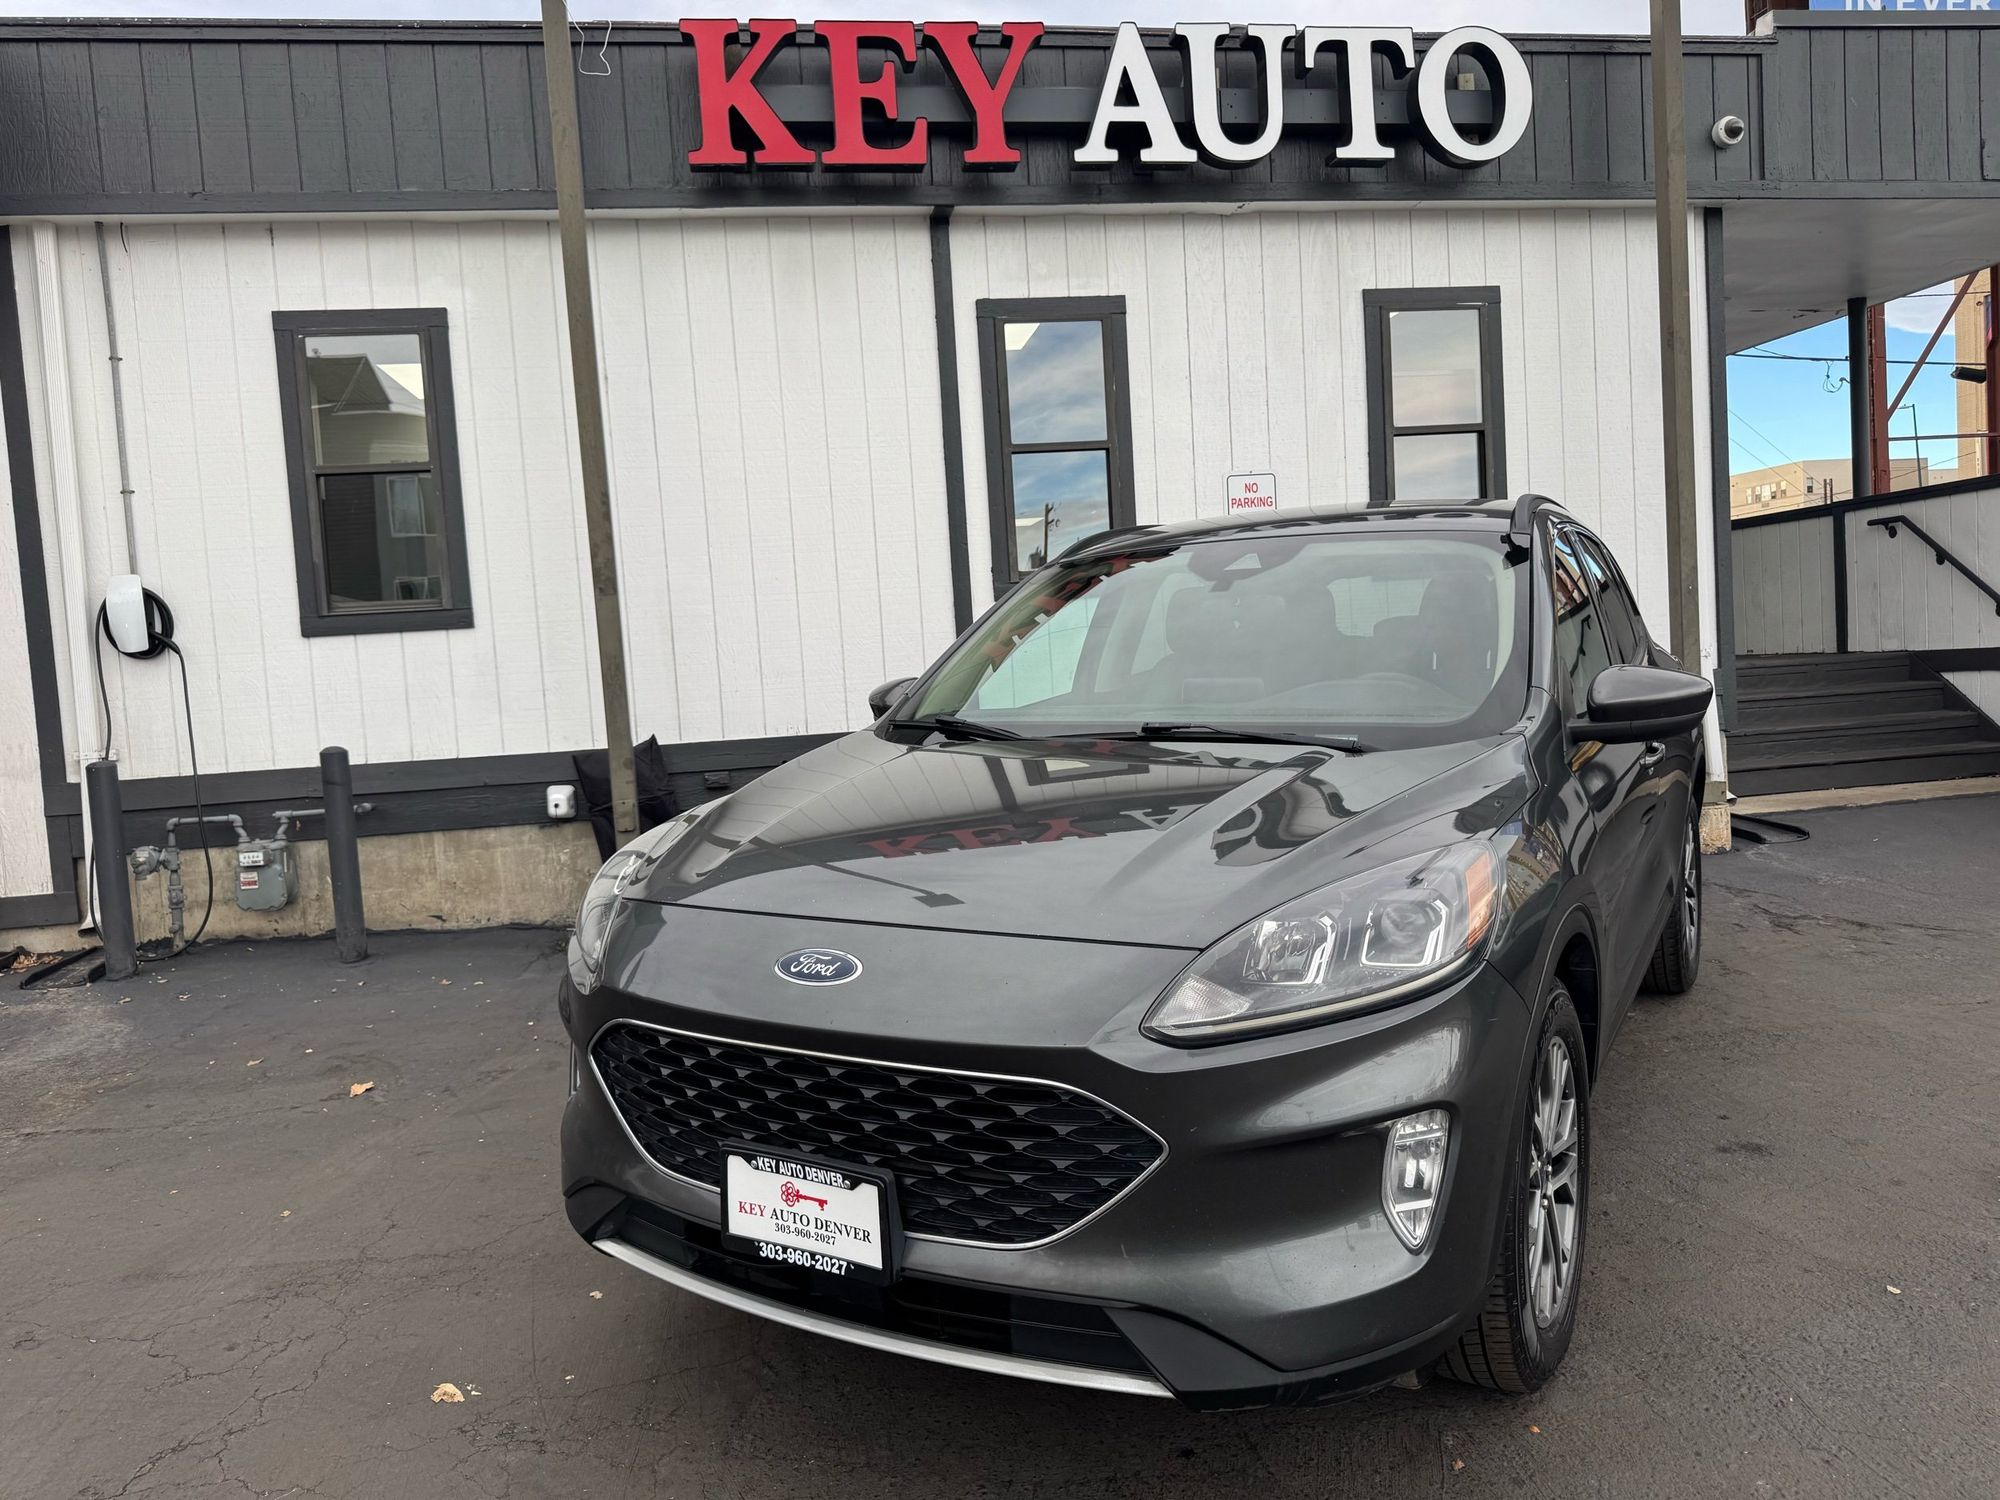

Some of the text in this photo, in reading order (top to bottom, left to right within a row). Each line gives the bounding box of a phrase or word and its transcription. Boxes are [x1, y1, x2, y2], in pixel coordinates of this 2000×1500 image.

[678, 18, 1533, 168] KEY AUTO
[1244, 482, 1259, 494] NO
[1231, 496, 1273, 509] PARKING
[790, 953, 841, 977] Ford
[756, 1156, 844, 1188] KEY AUTO DENVER
[738, 1200, 872, 1244] KEY AUTO DENVER
[774, 1222, 837, 1246] 303-960-2027
[759, 1241, 848, 1276] 303-960-2027
